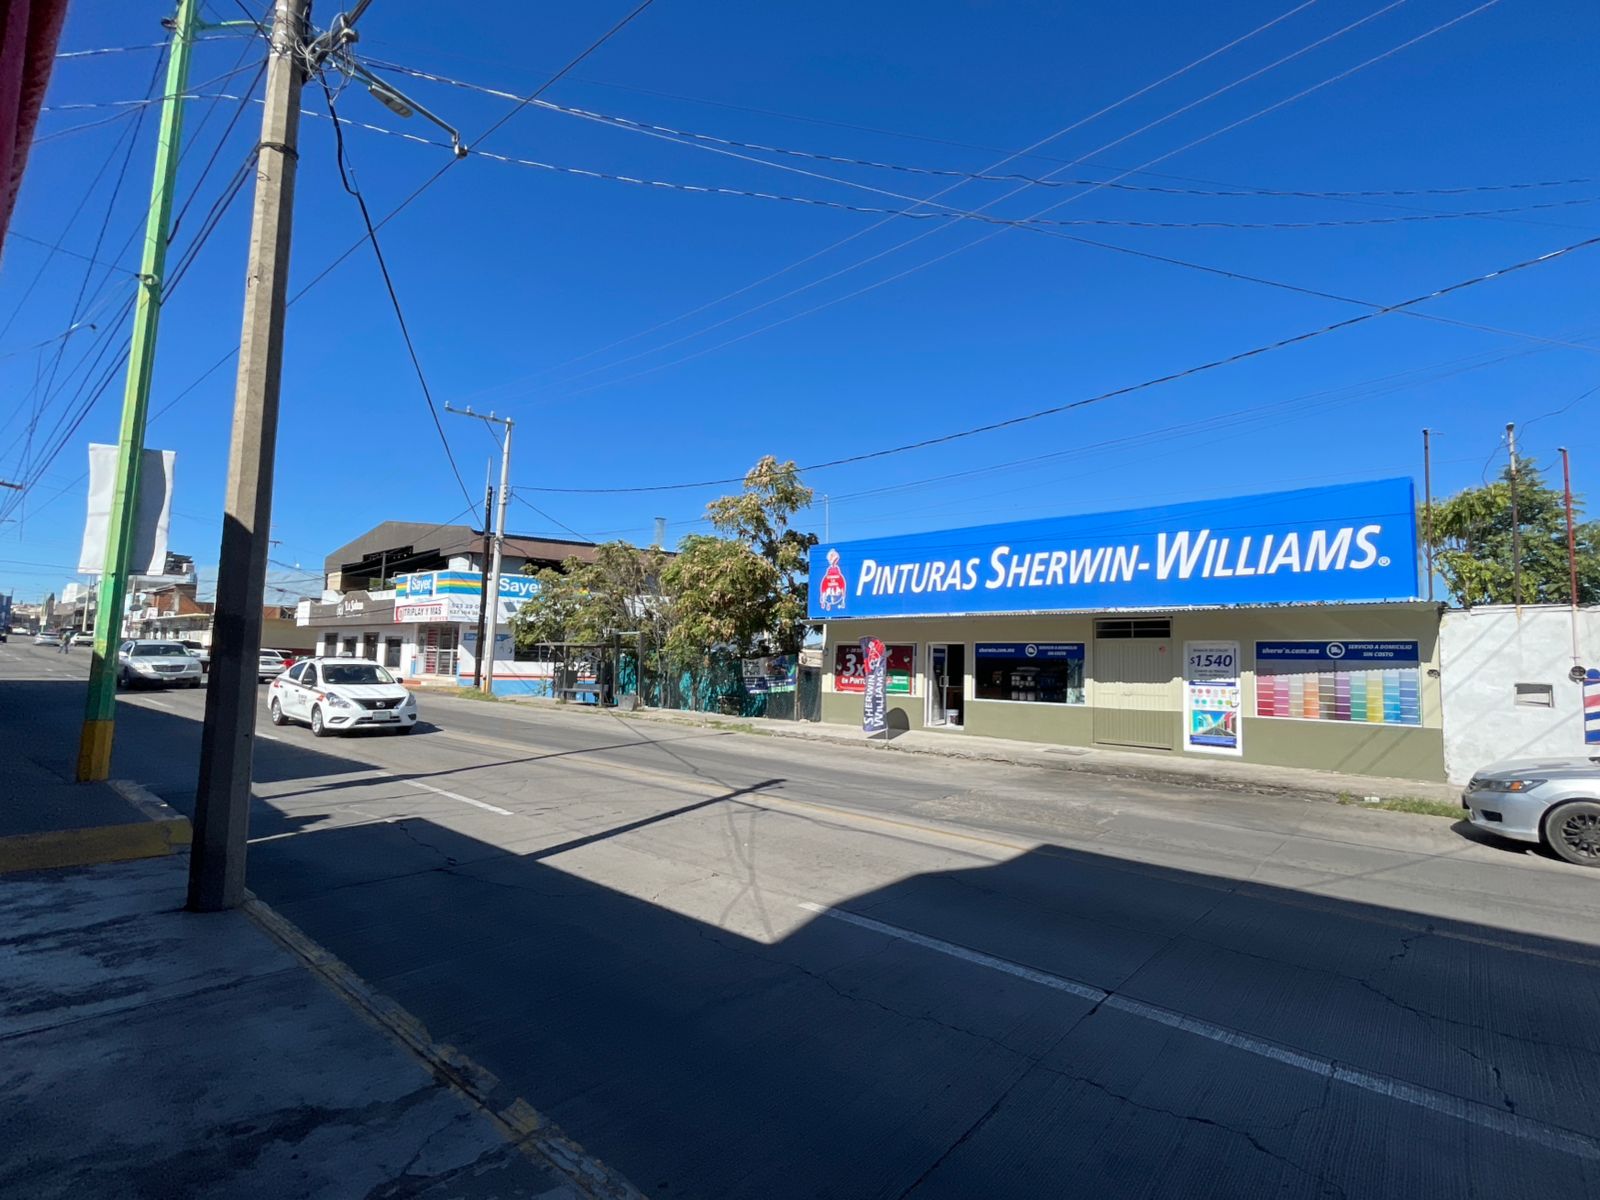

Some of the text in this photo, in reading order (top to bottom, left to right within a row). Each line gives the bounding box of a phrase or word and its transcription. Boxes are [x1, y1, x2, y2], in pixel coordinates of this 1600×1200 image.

[411, 577, 432, 592] Sayer
[856, 556, 980, 597] PINTURAS
[403, 606, 424, 617] TRIPLAY
[842, 654, 865, 677] 3x
[864, 675, 875, 725] SHERWIN
